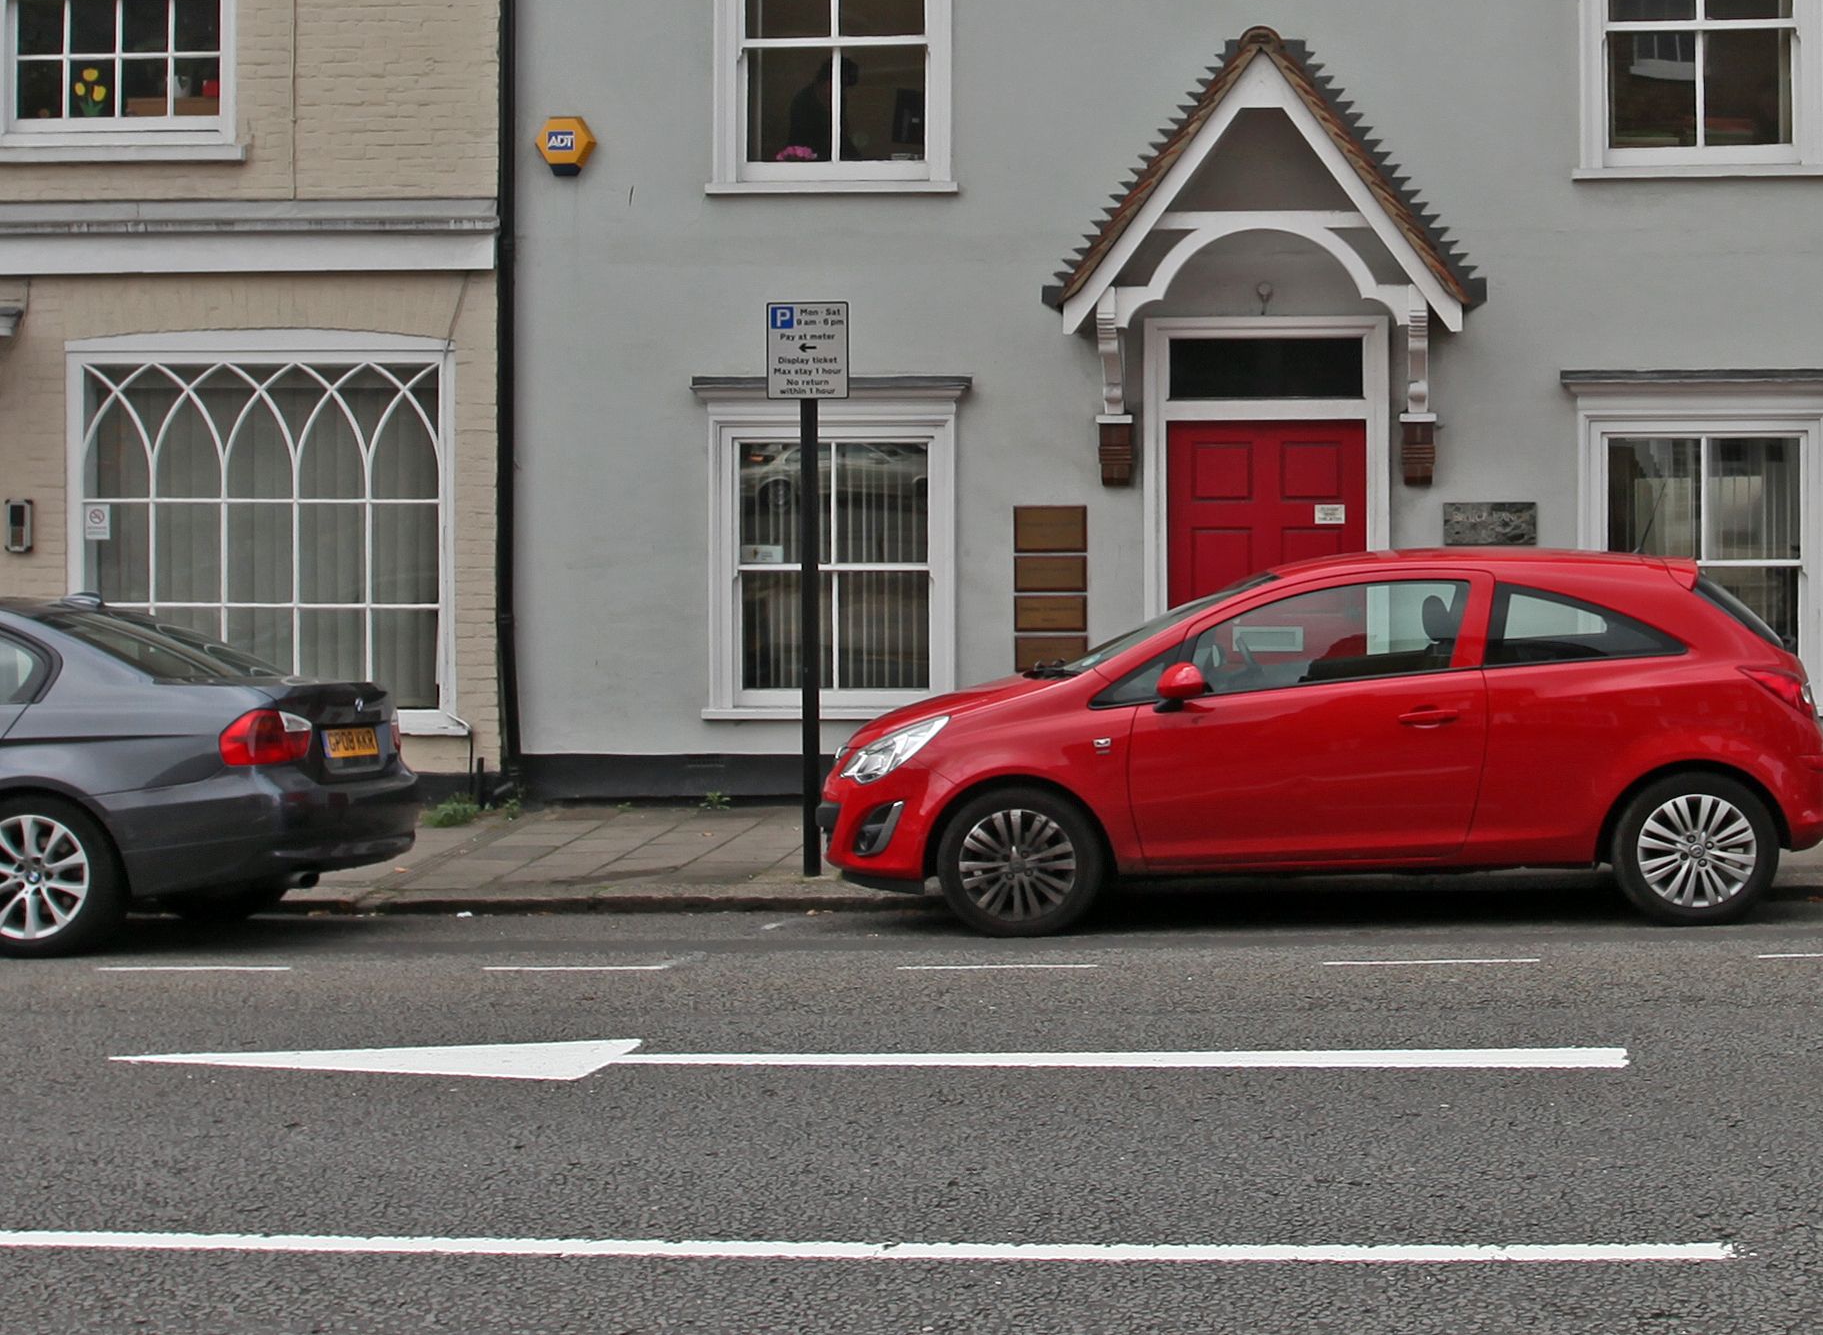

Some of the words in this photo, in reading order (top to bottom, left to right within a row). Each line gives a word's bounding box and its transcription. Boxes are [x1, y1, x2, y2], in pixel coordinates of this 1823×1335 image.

[547, 135, 575, 148] ADT
[800, 308, 819, 316] Mon
[825, 307, 841, 316] Sat
[780, 332, 796, 342] Pay
[810, 332, 836, 340] meter
[778, 356, 810, 365] Display
[812, 356, 838, 364] ticket
[773, 367, 791, 375] Max
[794, 367, 813, 376] stay
[821, 367, 842, 375] hour
[786, 378, 800, 386] No
[801, 378, 830, 386] return
[780, 387, 807, 395] within
[815, 387, 836, 395] hour
